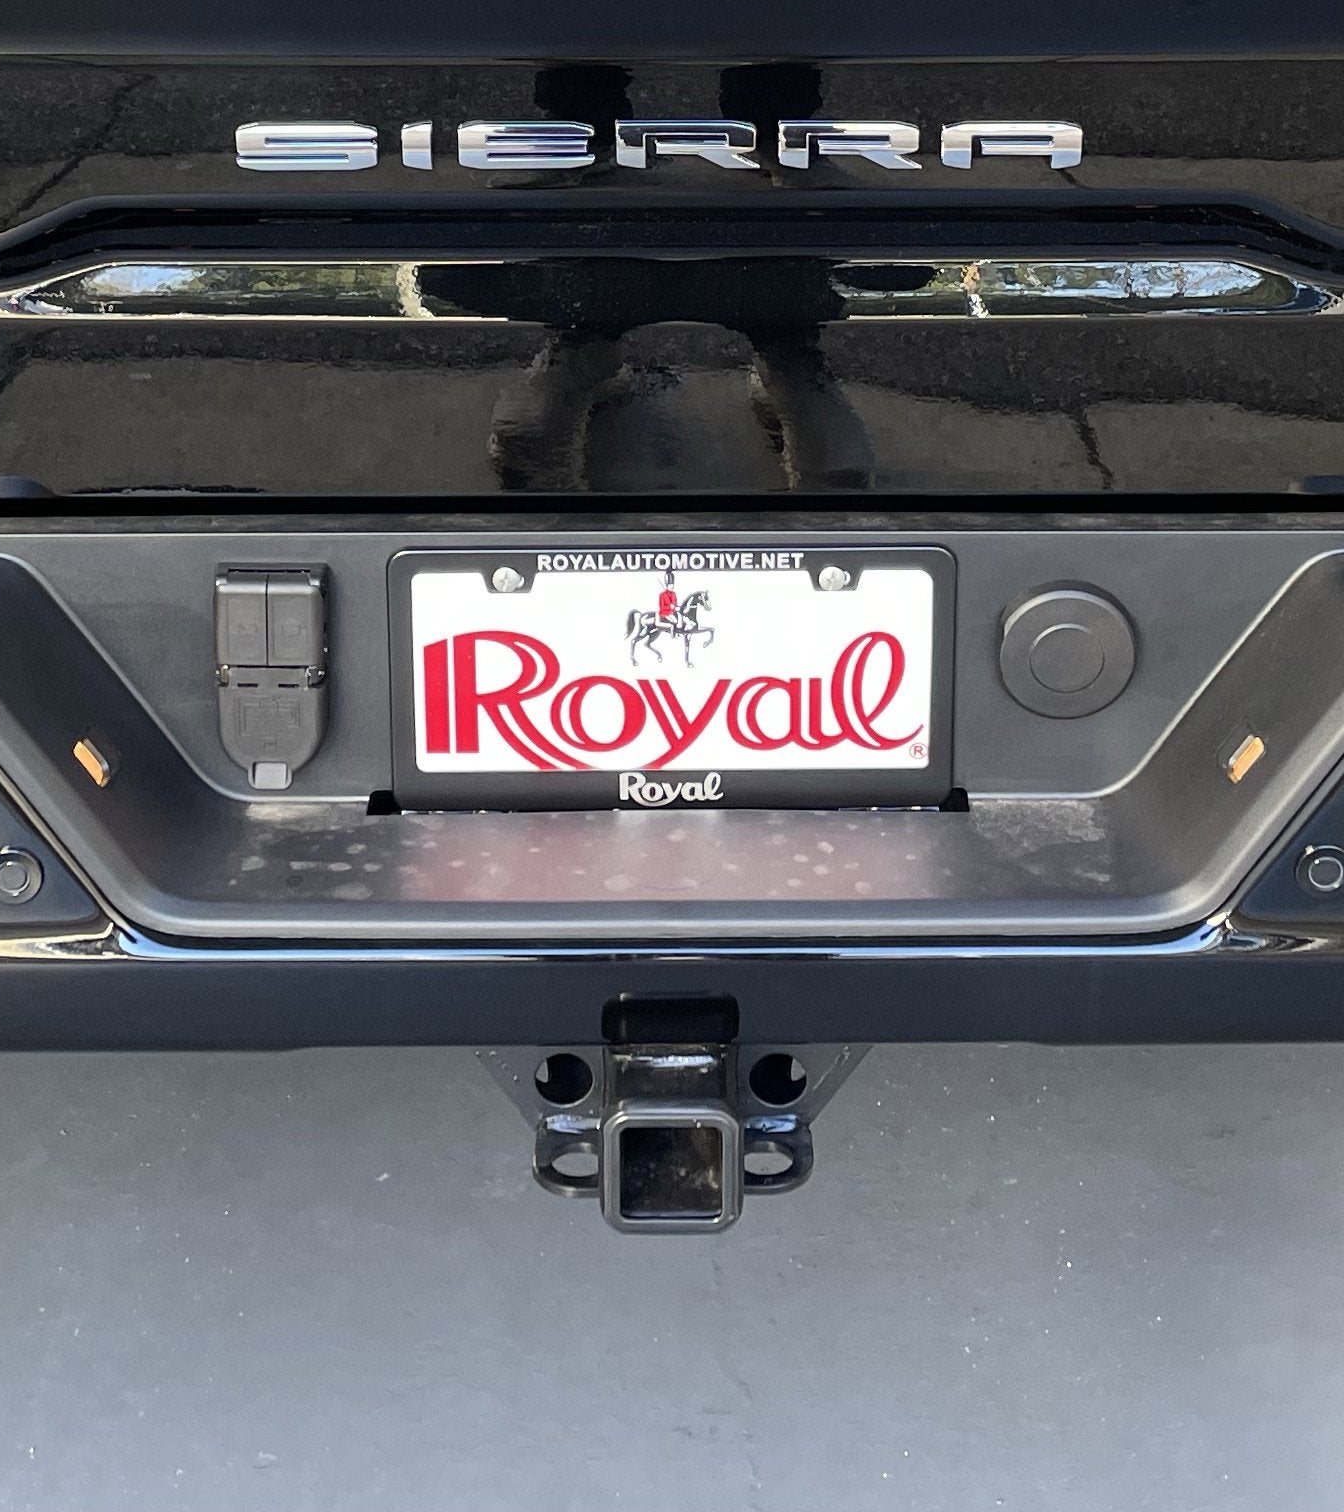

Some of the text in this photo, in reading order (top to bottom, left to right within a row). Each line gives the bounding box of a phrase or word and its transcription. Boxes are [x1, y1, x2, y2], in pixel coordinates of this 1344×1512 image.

[235, 120, 1084, 170] SIERRA
[536, 552, 805, 571] ROYALAUTOMOTIVE.NET
[423, 630, 925, 770] Royal
[619, 772, 724, 807] Royal
